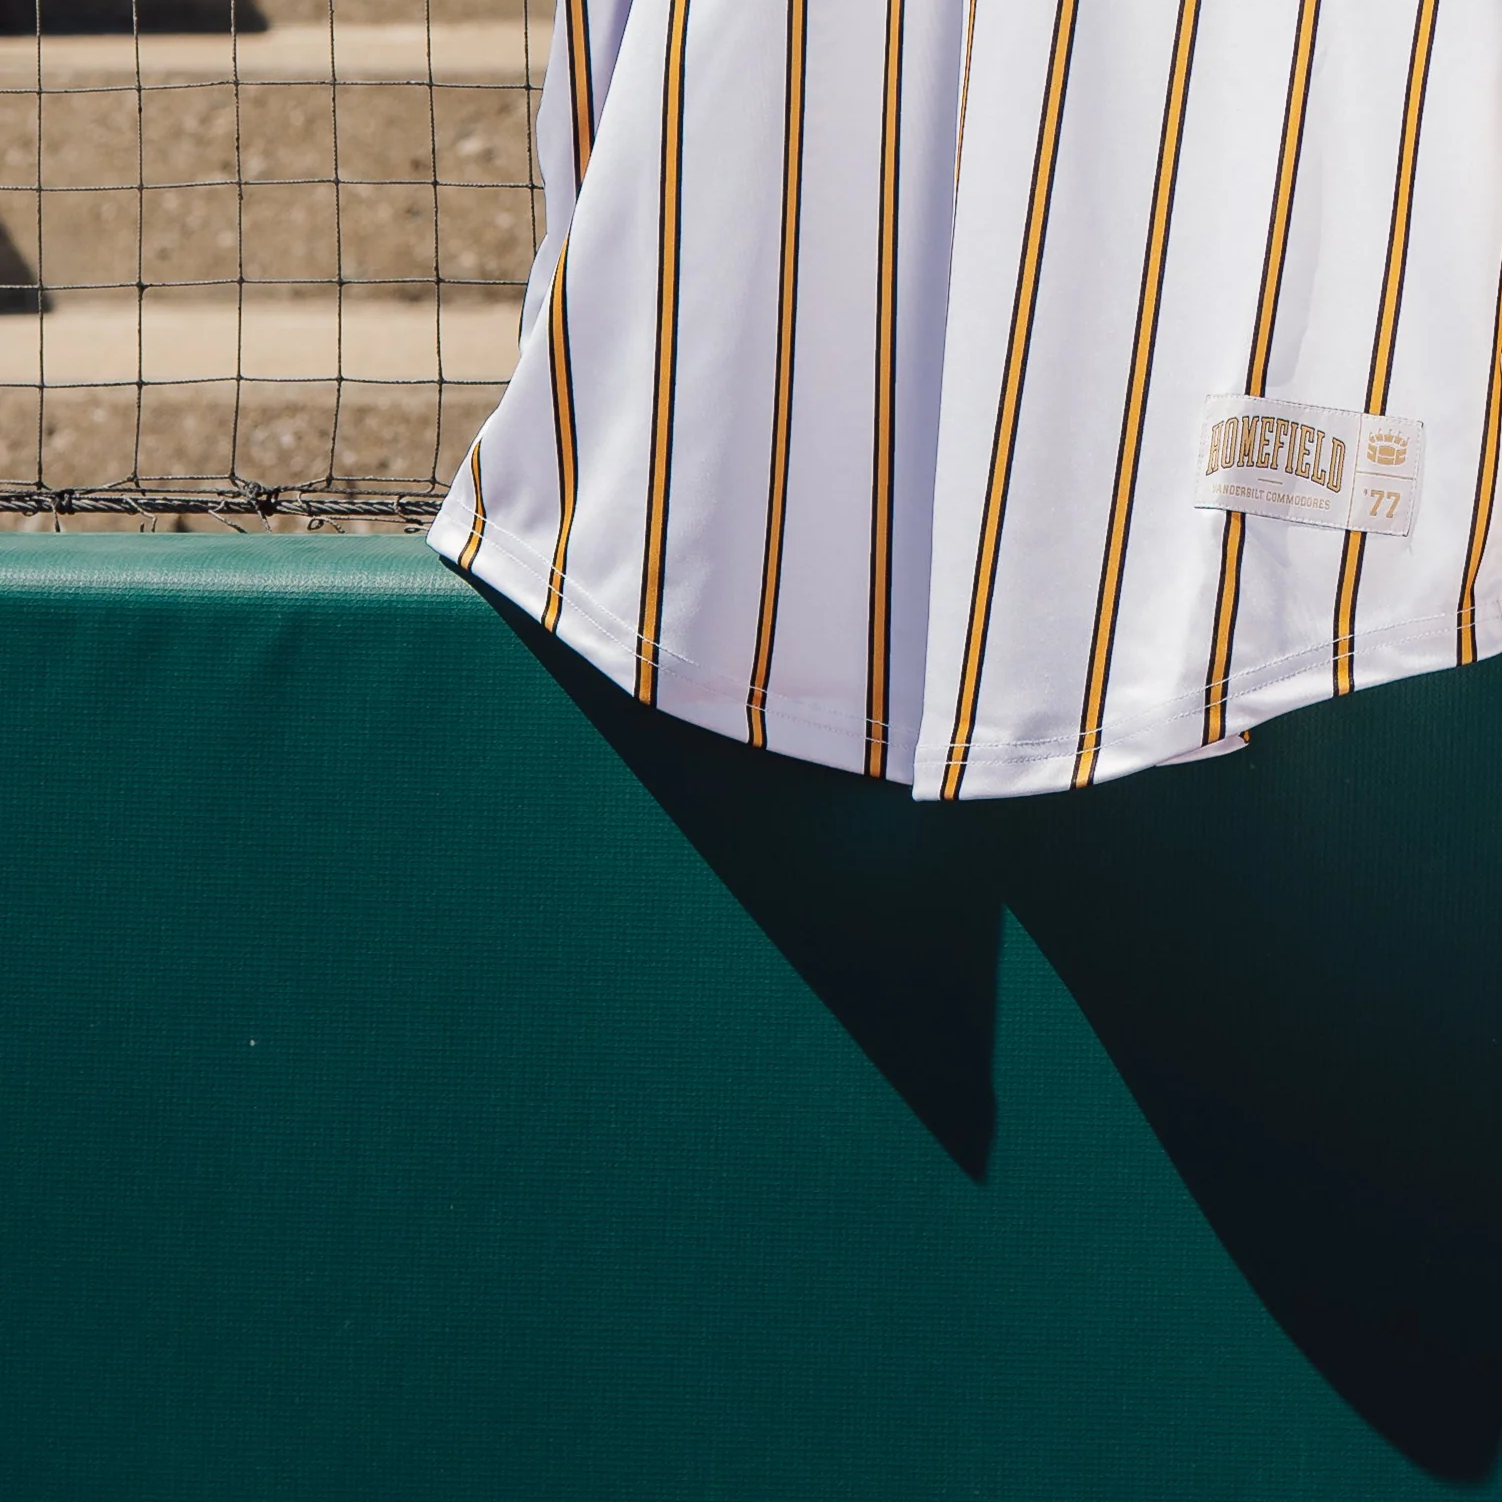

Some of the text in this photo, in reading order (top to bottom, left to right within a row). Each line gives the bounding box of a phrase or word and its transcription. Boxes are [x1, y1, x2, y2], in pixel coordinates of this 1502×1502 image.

[1205, 415, 1347, 494] HOMEFIELD
[1212, 484, 1332, 510] VANDERBILT COMMODORES
